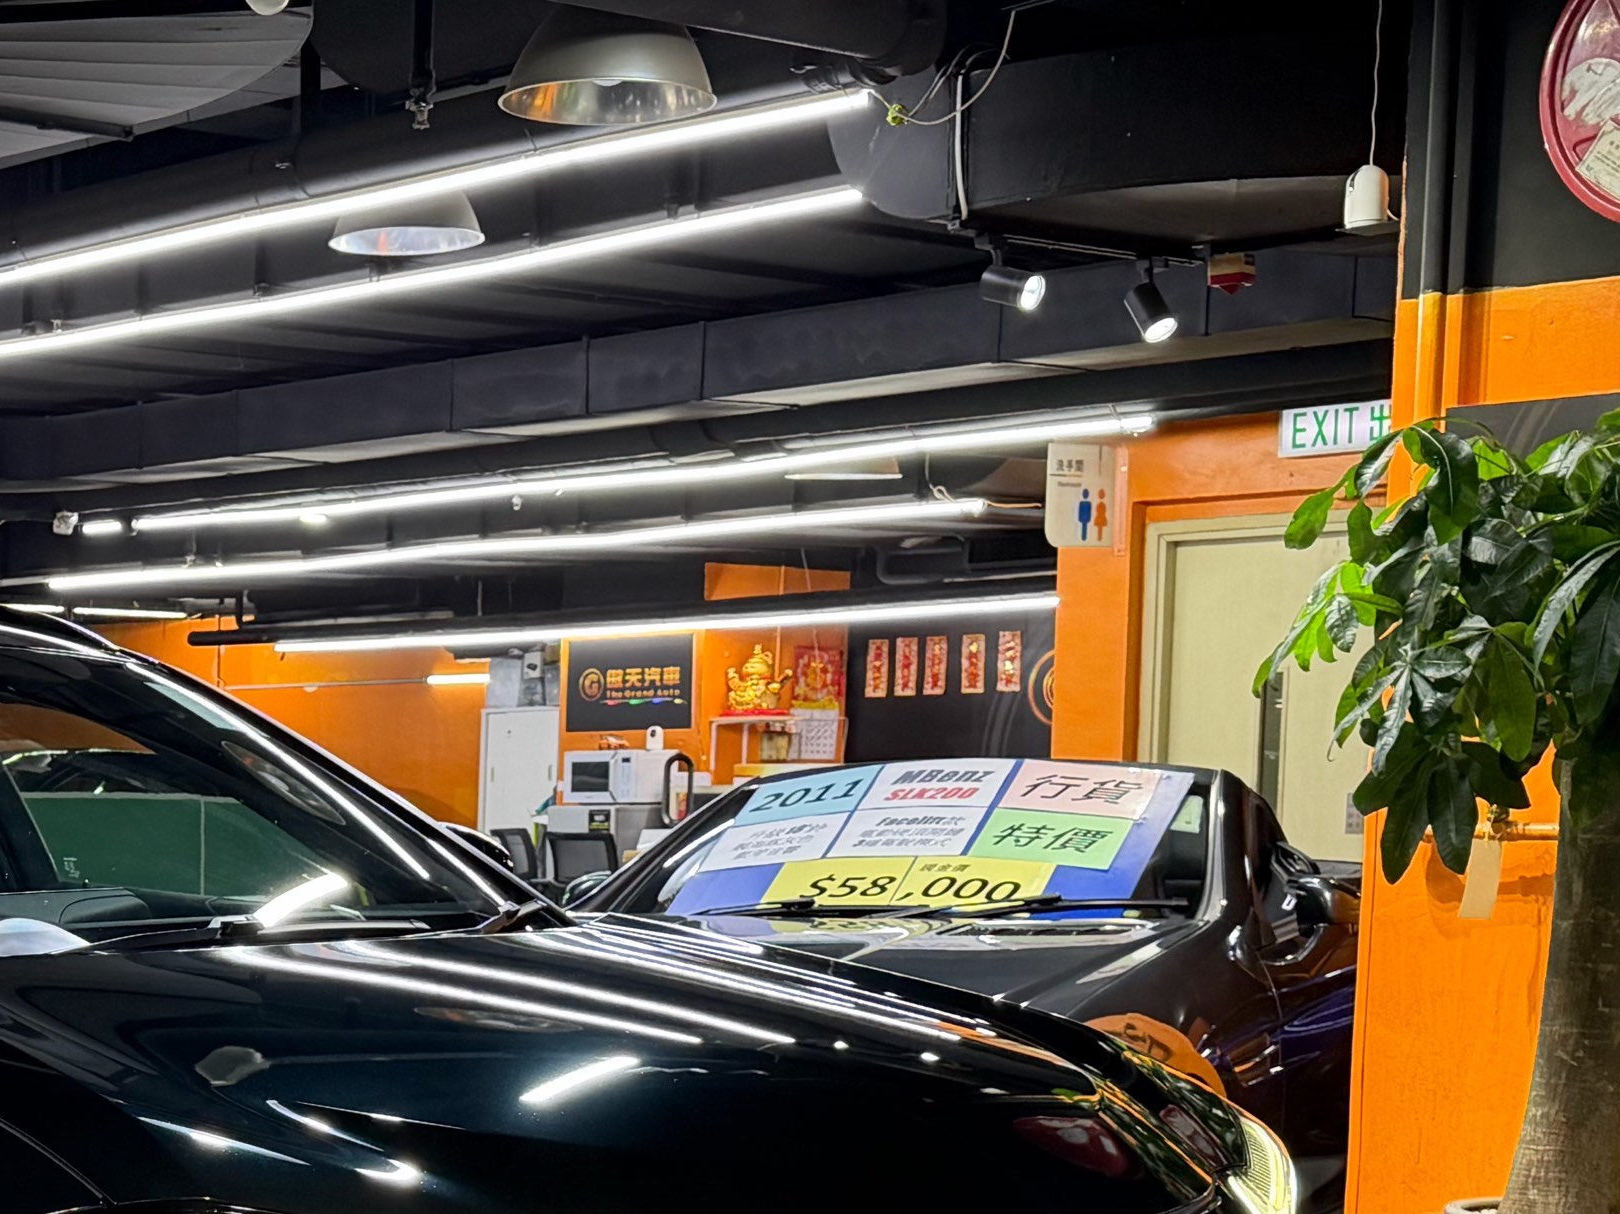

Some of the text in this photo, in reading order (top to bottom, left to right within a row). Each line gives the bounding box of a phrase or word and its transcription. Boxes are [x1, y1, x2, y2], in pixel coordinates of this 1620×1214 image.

[1292, 407, 1359, 449] EXIT
[749, 778, 865, 813] 2011
[883, 787, 980, 801] SLK200
[1021, 774, 1143, 804] 行貨
[992, 823, 1114, 853] 特價
[799, 873, 1022, 902] $58,000
